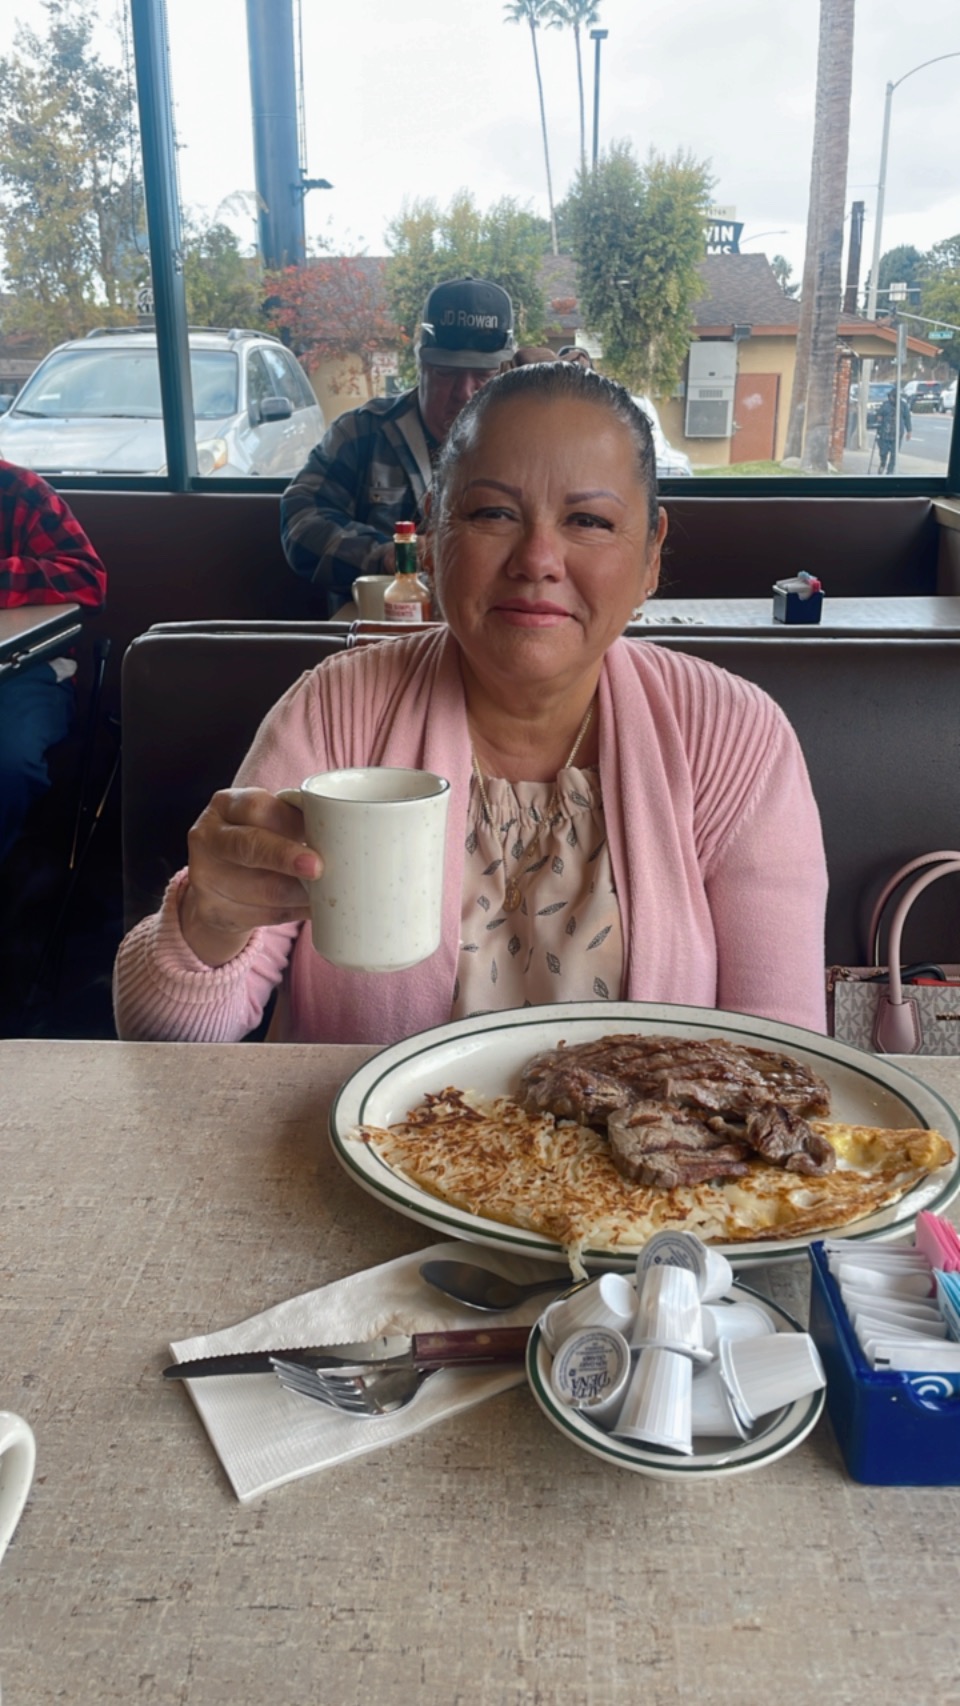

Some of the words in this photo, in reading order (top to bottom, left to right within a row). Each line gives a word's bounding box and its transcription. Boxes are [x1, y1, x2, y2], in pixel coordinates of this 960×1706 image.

[440, 310, 455, 326] JD
[458, 310, 499, 329] Rowan
[571, 1371, 611, 1391] DENA
[571, 1385, 604, 1399] ALTA
